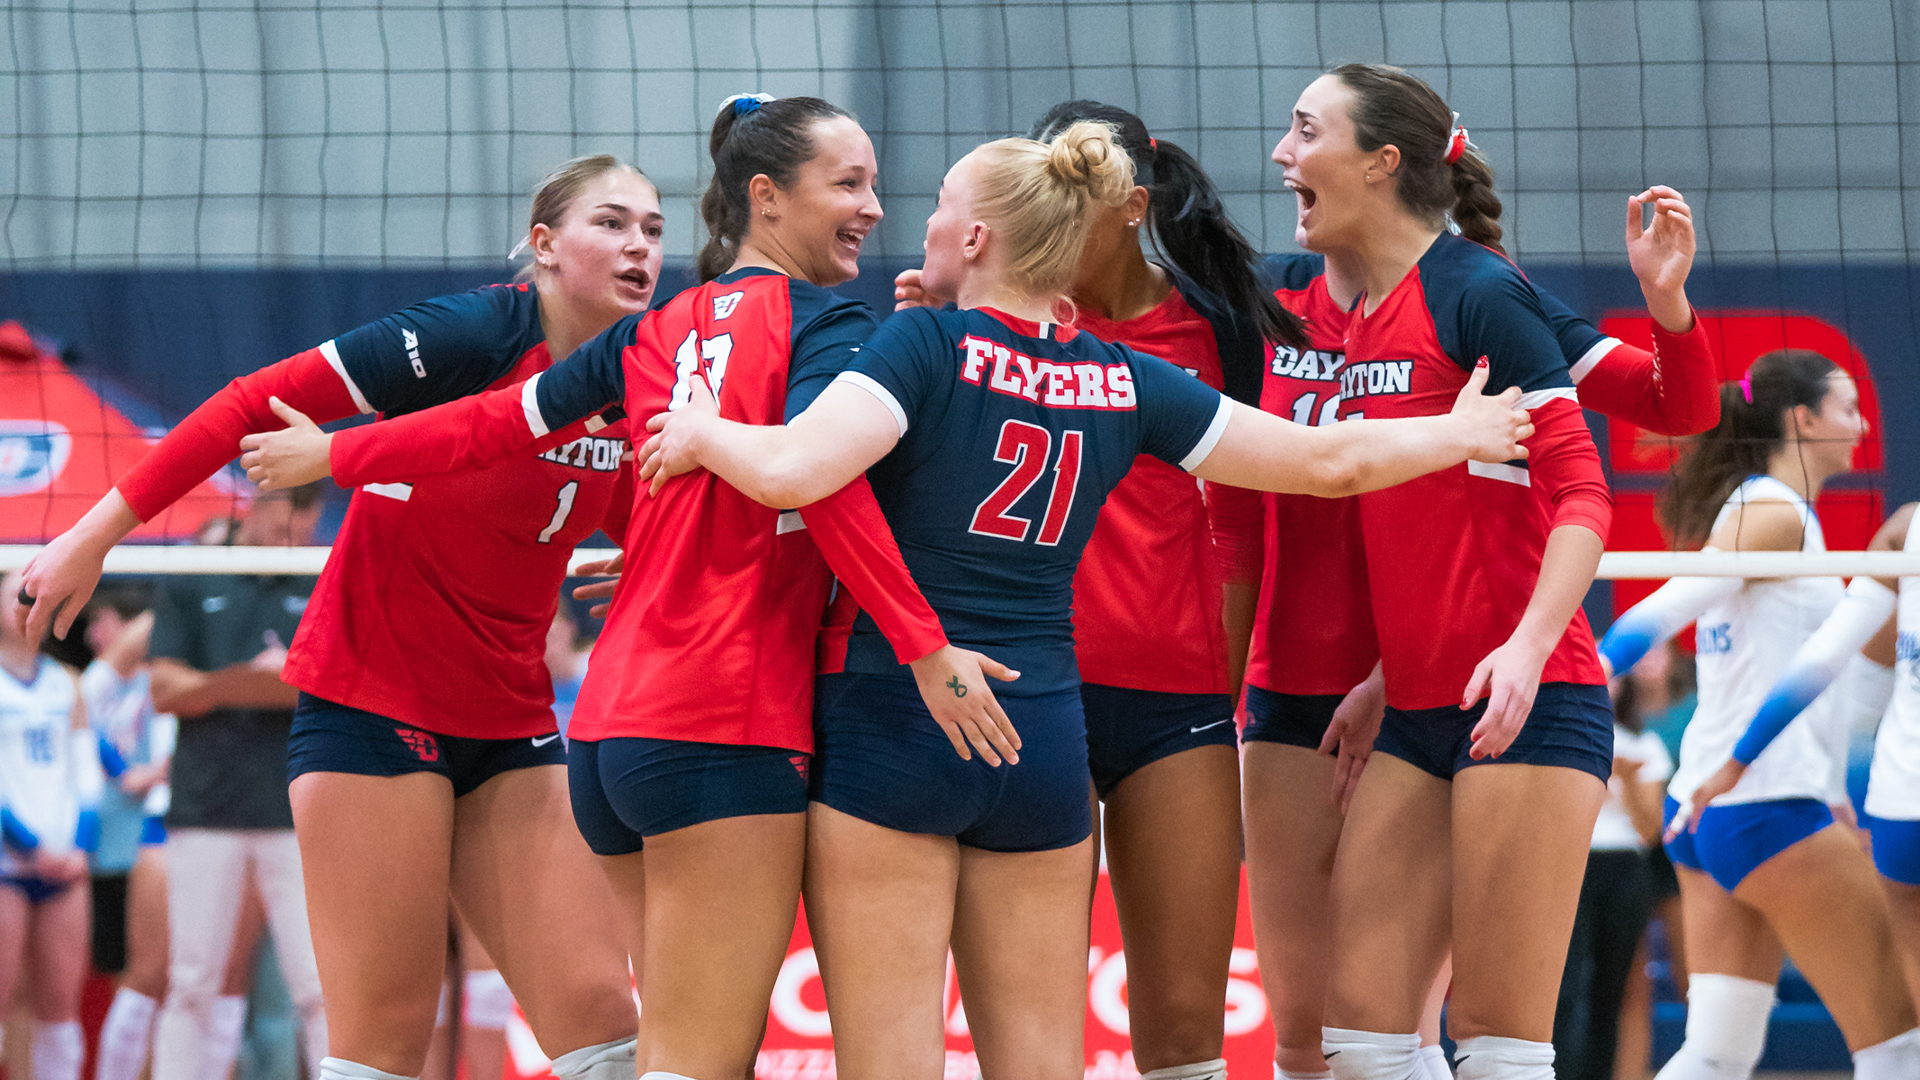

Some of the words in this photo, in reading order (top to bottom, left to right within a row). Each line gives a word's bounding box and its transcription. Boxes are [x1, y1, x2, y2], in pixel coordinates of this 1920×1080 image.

[401, 328, 427, 379] A10
[959, 333, 1137, 411] FLYERS
[536, 480, 579, 543] 1
[968, 419, 1083, 546] 21
